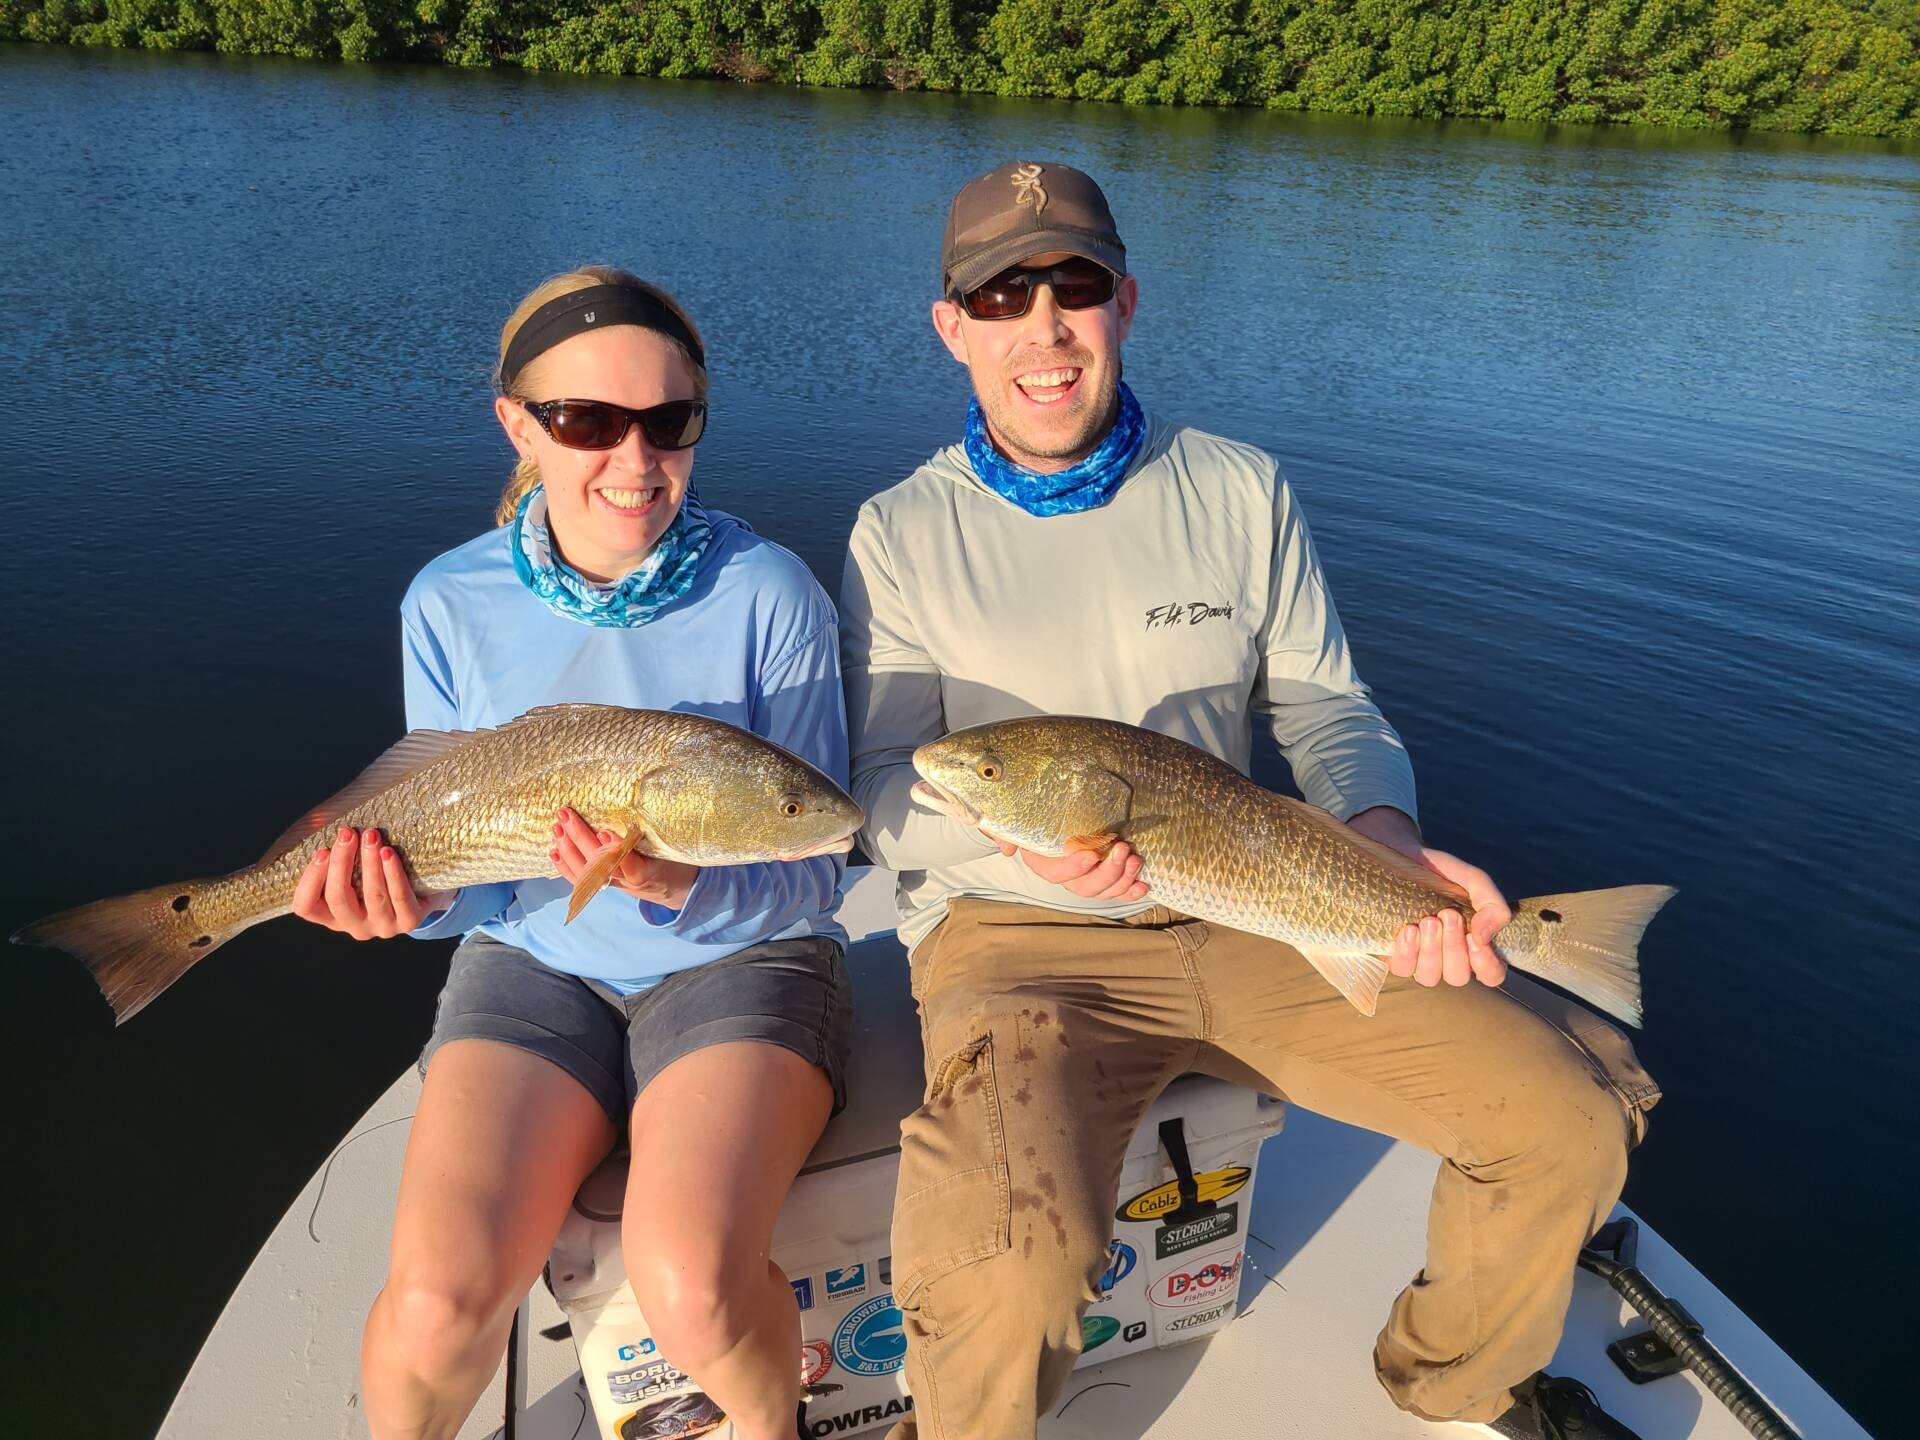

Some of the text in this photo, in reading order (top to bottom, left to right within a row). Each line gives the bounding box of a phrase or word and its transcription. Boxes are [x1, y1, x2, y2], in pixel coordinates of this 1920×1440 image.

[1187, 600, 1235, 625] Davis
[1139, 1193, 1178, 1213] Cablz
[1209, 1228, 1228, 1238] EARTH
[1183, 1286, 1217, 1303] Fishing
[842, 1298, 888, 1335] BROWN'S
[840, 1336, 853, 1359] PAUL
[857, 1361, 880, 1371] B&L
[651, 1370, 681, 1384] TO
